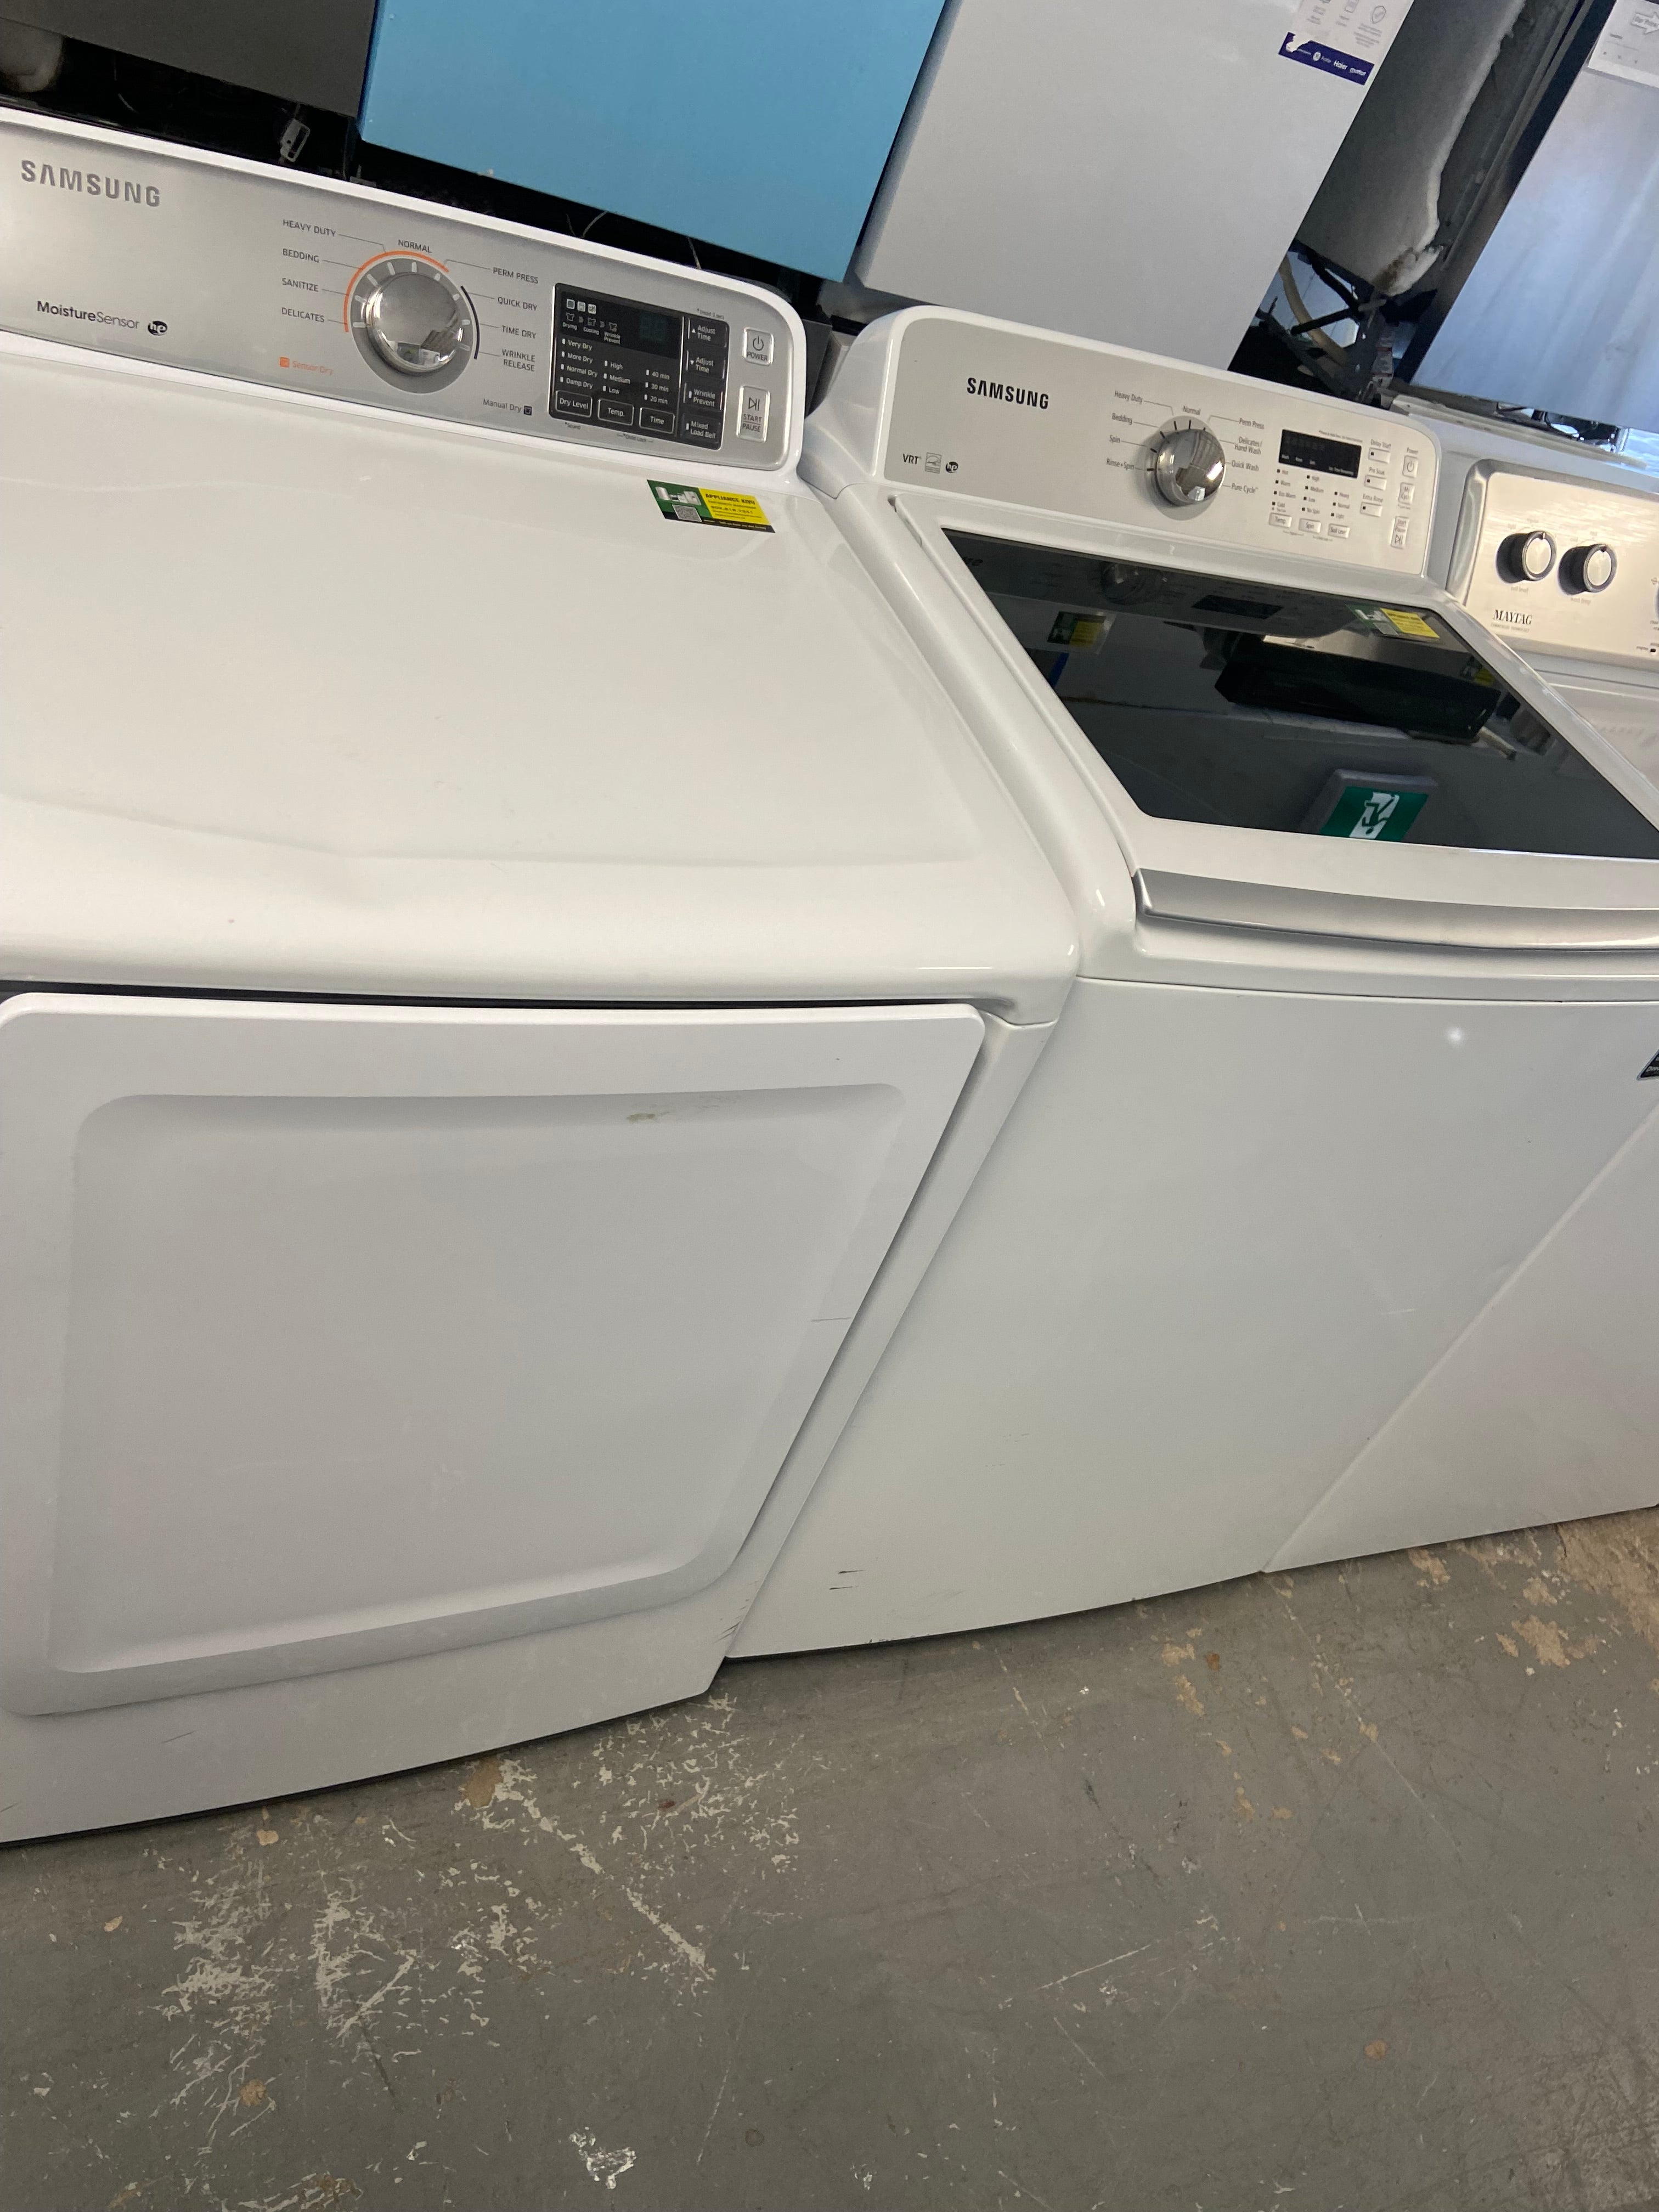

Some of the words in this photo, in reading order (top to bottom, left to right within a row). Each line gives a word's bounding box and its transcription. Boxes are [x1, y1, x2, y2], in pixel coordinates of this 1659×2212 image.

[21, 161, 161, 207] SAMSUNG
[283, 219, 311, 232] HEAVY
[314, 225, 336, 237] DUTY
[398, 239, 432, 253] NORMAL
[283, 248, 319, 263] BEDDING
[493, 267, 514, 279] PERM
[516, 272, 539, 284] PRESS
[282, 278, 319, 292] SANITIZE
[498, 297, 521, 308] QUICK
[523, 302, 538, 312] DRY
[281, 307, 324, 323] DELICATES
[502, 325, 519, 336] TIME
[522, 330, 537, 340] DRY
[698, 325, 715, 335] Adjust
[697, 332, 711, 342] Time
[568, 340, 581, 349] Very
[582, 343, 592, 351] Dry
[502, 349, 535, 363] WRINKLE
[567, 353, 582, 361] More
[583, 356, 593, 364] Dry
[696, 357, 714, 366] Adjust
[747, 351, 768, 362] POWER
[292, 361, 318, 370] Sensor
[504, 359, 535, 372] RELEASE
[610, 362, 623, 370] High
[696, 364, 709, 374] Time
[567, 365, 586, 375] Normal
[588, 370, 598, 378] Dry
[566, 378, 582, 387] Damp
[583, 381, 593, 390] Dry
[610, 374, 631, 384] Medium
[693, 389, 715, 399] Wrinkle
[967, 377, 1049, 410] SAMSUNG
[1115, 391, 1130, 402] Heavy
[1131, 394, 1143, 404] Duty
[483, 398, 507, 410] Manual
[509, 404, 521, 414] Dry
[560, 398, 571, 407] Dry
[573, 400, 589, 410] Level
[693, 397, 715, 407] Prevent
[1183, 405, 1201, 415] Normal
[650, 416, 664, 425] Time
[743, 414, 762, 423] START
[1112, 413, 1132, 425] Bedding
[1239, 417, 1251, 427] Perm
[1252, 420, 1265, 430] Press
[691, 421, 708, 430] Mixed
[742, 424, 761, 433] PAUSE
[690, 429, 704, 437] Load
[1109, 435, 1120, 444] Spin
[1248, 446, 1261, 455] Wash
[1231, 460, 1244, 469] Quick
[1246, 462, 1259, 471] Wash
[1493, 610, 1532, 625] MAYTAG
